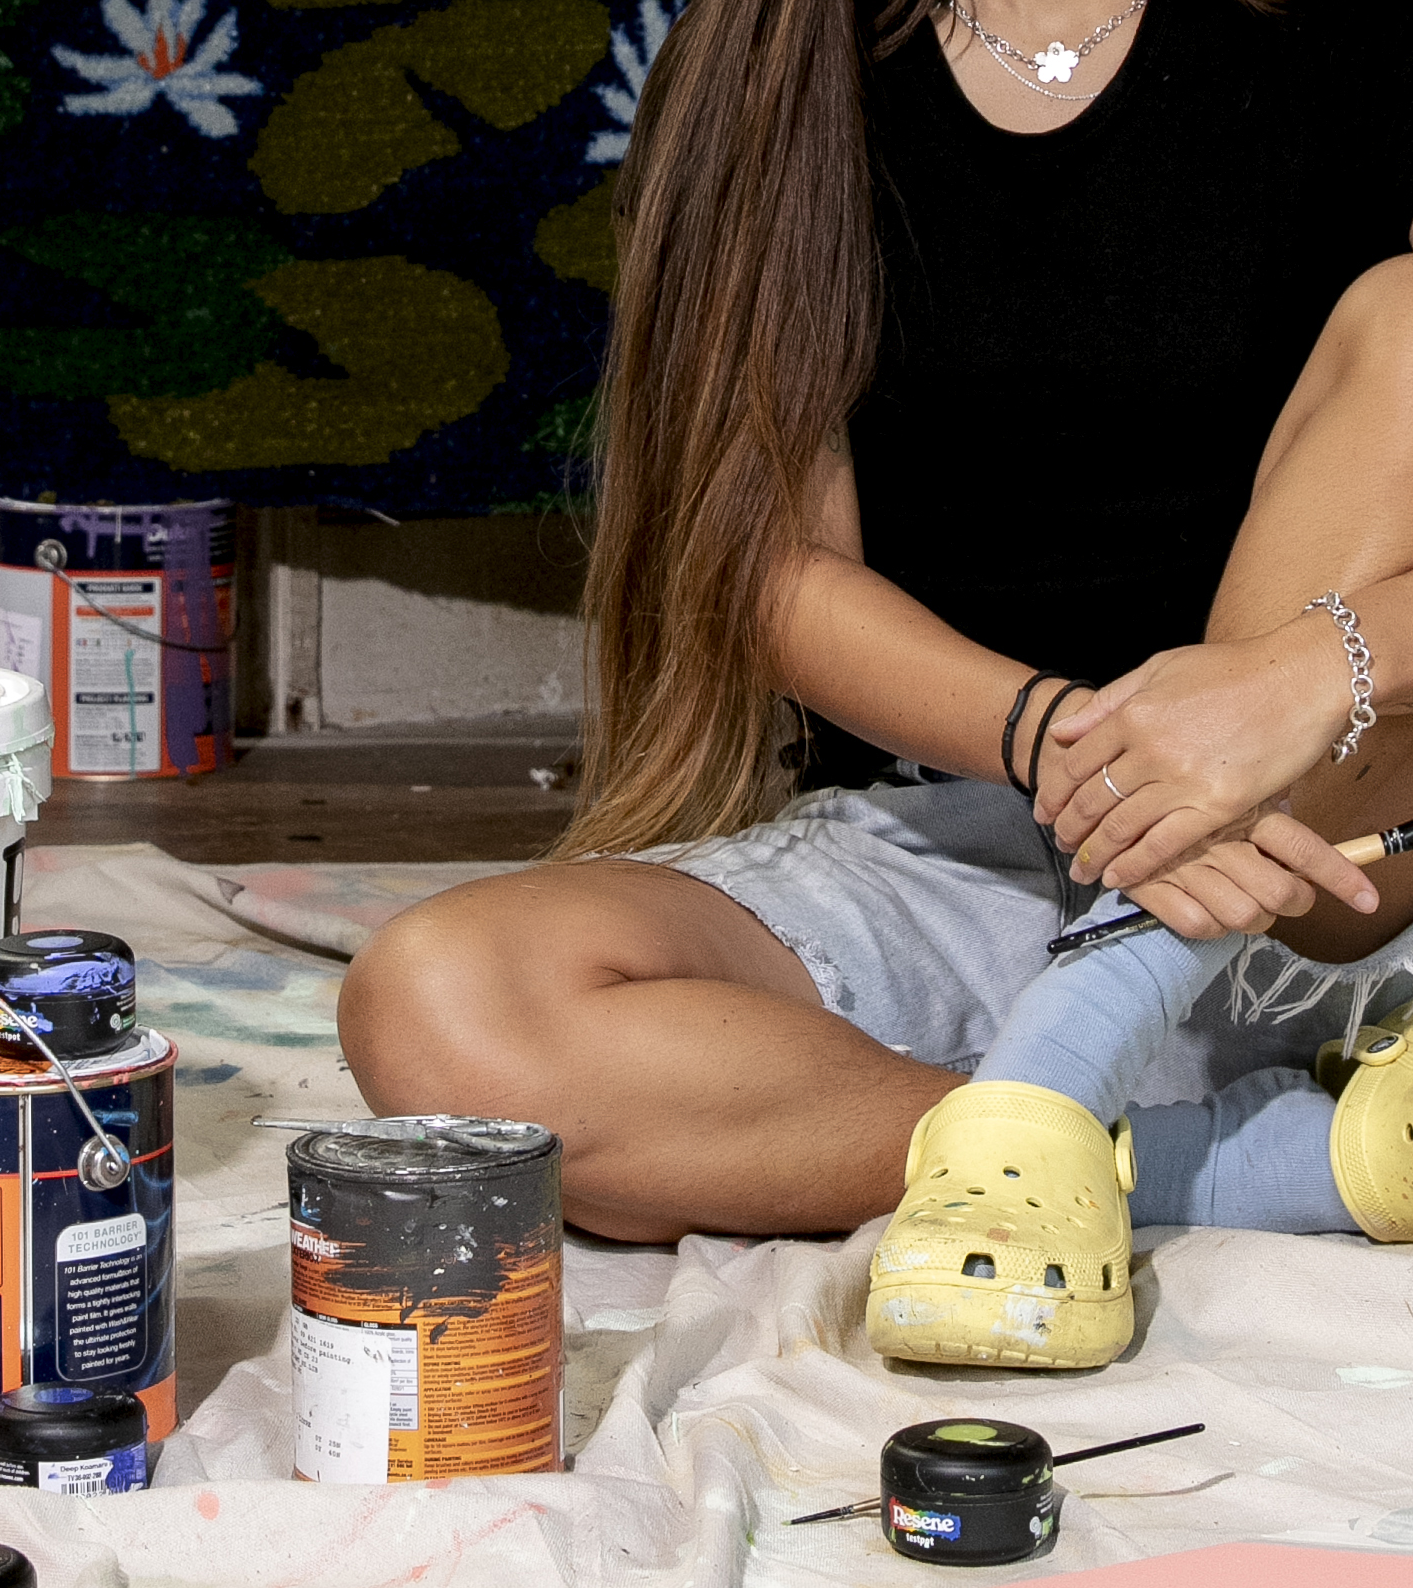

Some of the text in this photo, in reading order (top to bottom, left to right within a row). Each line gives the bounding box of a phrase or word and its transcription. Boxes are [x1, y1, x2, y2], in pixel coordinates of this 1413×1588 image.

[71, 1220, 138, 1242] 101 BARRIER
[68, 1232, 140, 1254] TECHNOLOGY
[64, 1266, 76, 1274] 101
[77, 1263, 99, 1273] Barrier
[99, 1257, 130, 1270] Technology
[67, 1278, 140, 1299] high quality materials that
[70, 1275, 101, 1286] advanced
[67, 1302, 86, 1311] forms
[92, 1296, 111, 1307] tightly
[111, 1289, 141, 1303] interlocking
[72, 1313, 89, 1323] paint
[90, 1310, 103, 1320] film.
[109, 1306, 124, 1317] gives
[70, 1324, 95, 1335] painted
[95, 1322, 108, 1331] with
[73, 1327, 137, 1346] the ultimate protection
[74, 1338, 136, 1358] to stay looking freshly
[318, 1349, 355, 1365] painting.
[81, 1354, 131, 1370] painted for years.
[893, 1505, 955, 1533] Resene
